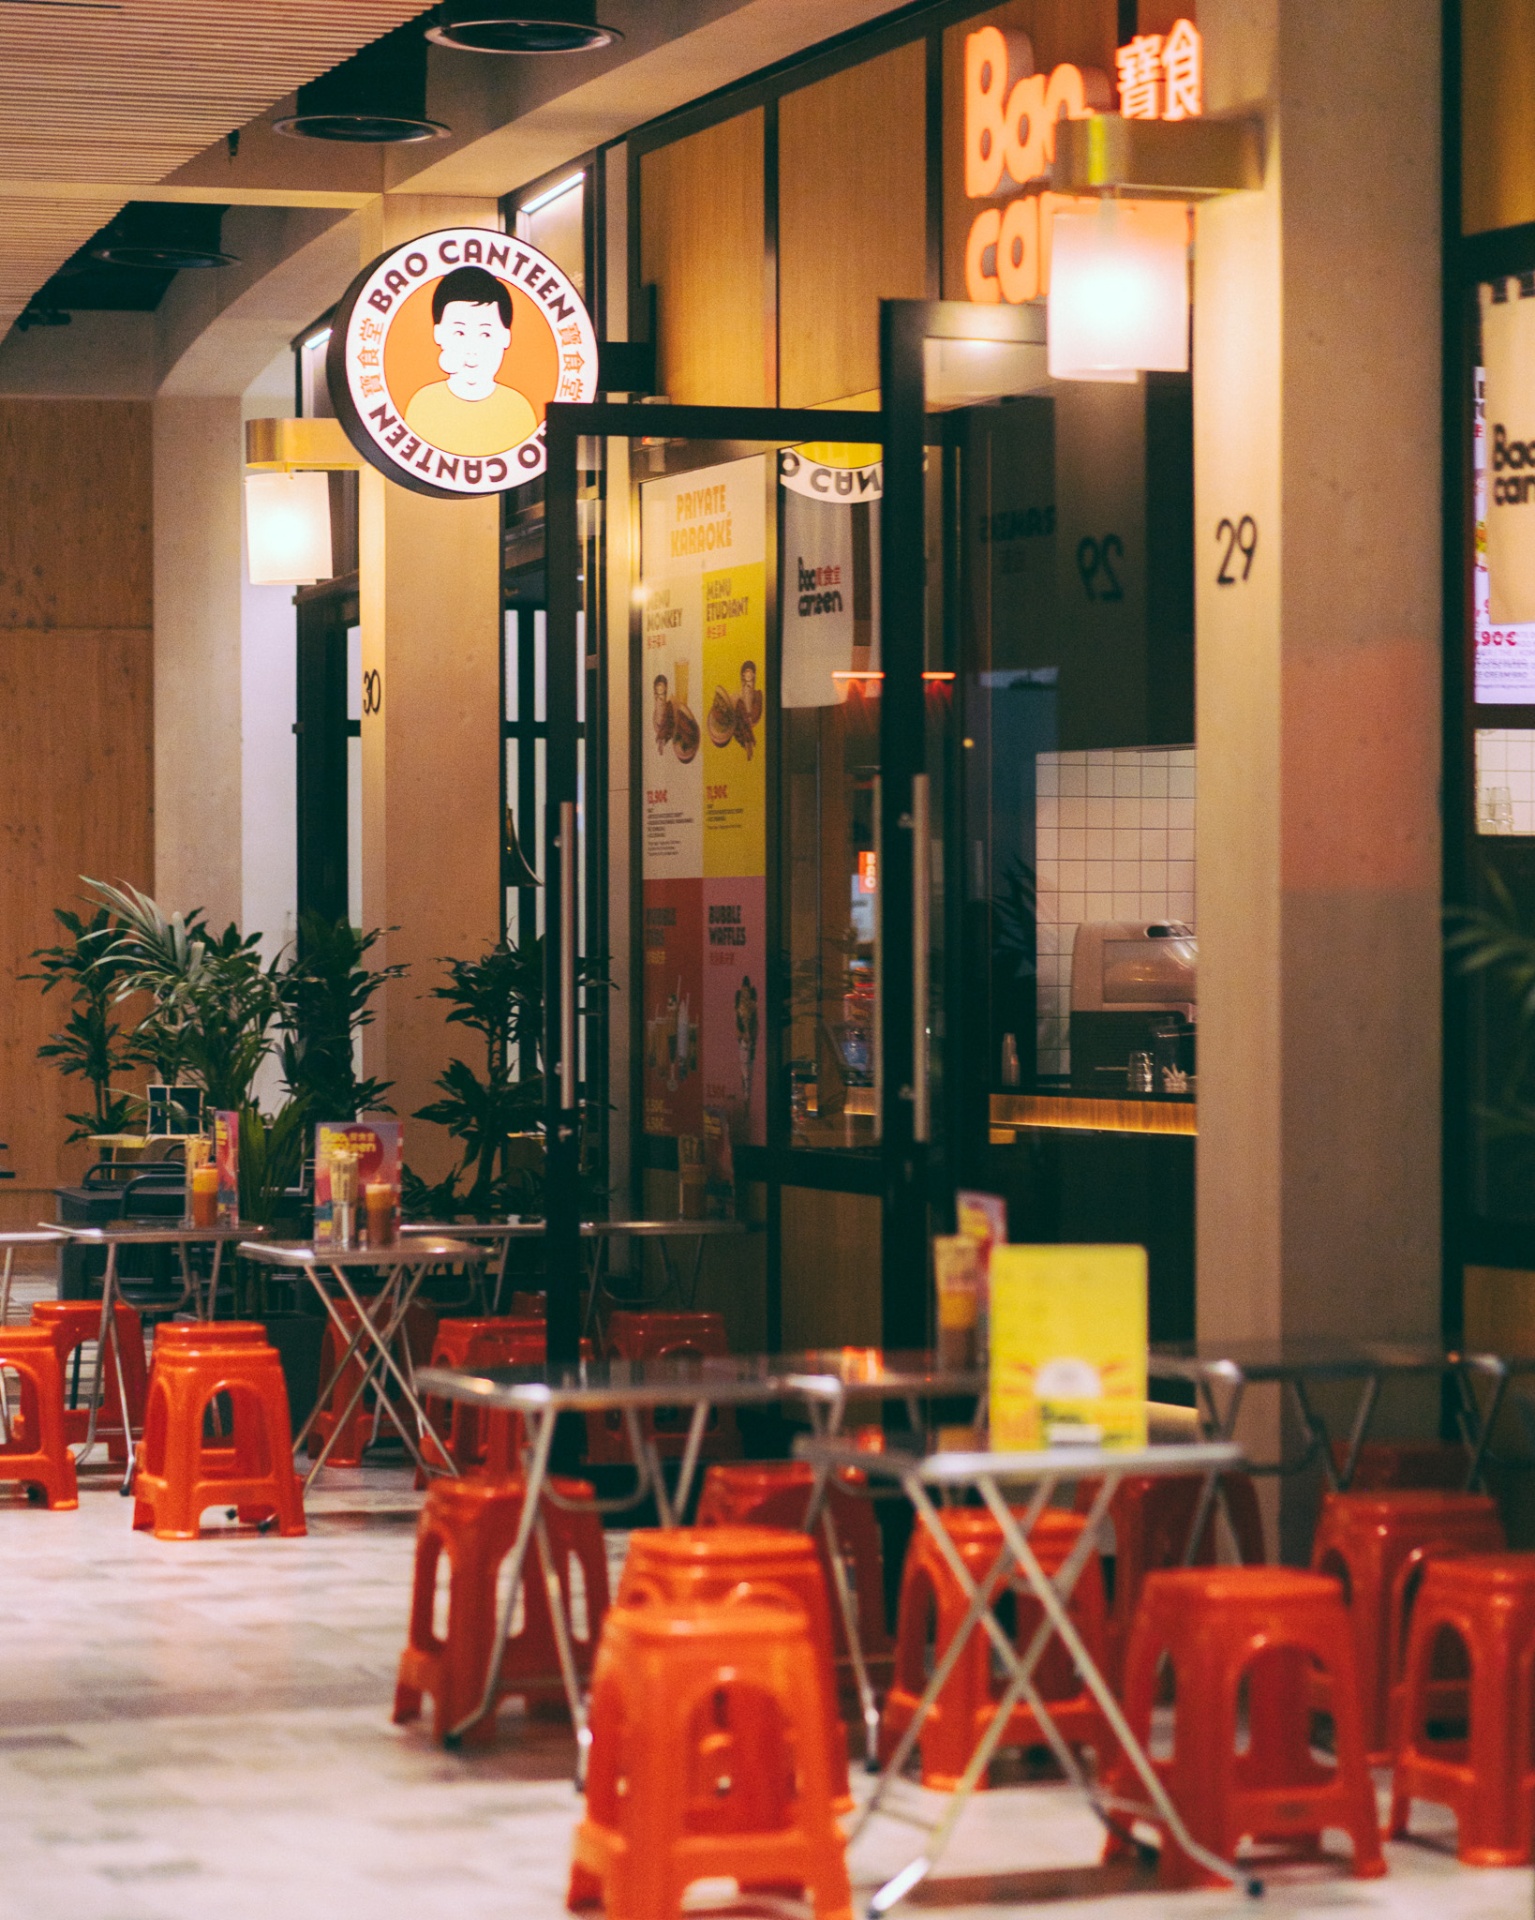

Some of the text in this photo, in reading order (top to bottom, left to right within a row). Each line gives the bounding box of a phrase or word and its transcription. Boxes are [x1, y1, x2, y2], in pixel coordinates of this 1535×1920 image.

[367, 238, 576, 323] BAO CANTEEN
[368, 402, 508, 484] CANTEEN
[676, 484, 726, 522] PRIVATE
[670, 511, 732, 558] KARAOKÉ
[1216, 515, 1257, 585] 29
[646, 608, 683, 632] MONKEY
[363, 669, 381, 716] 30
